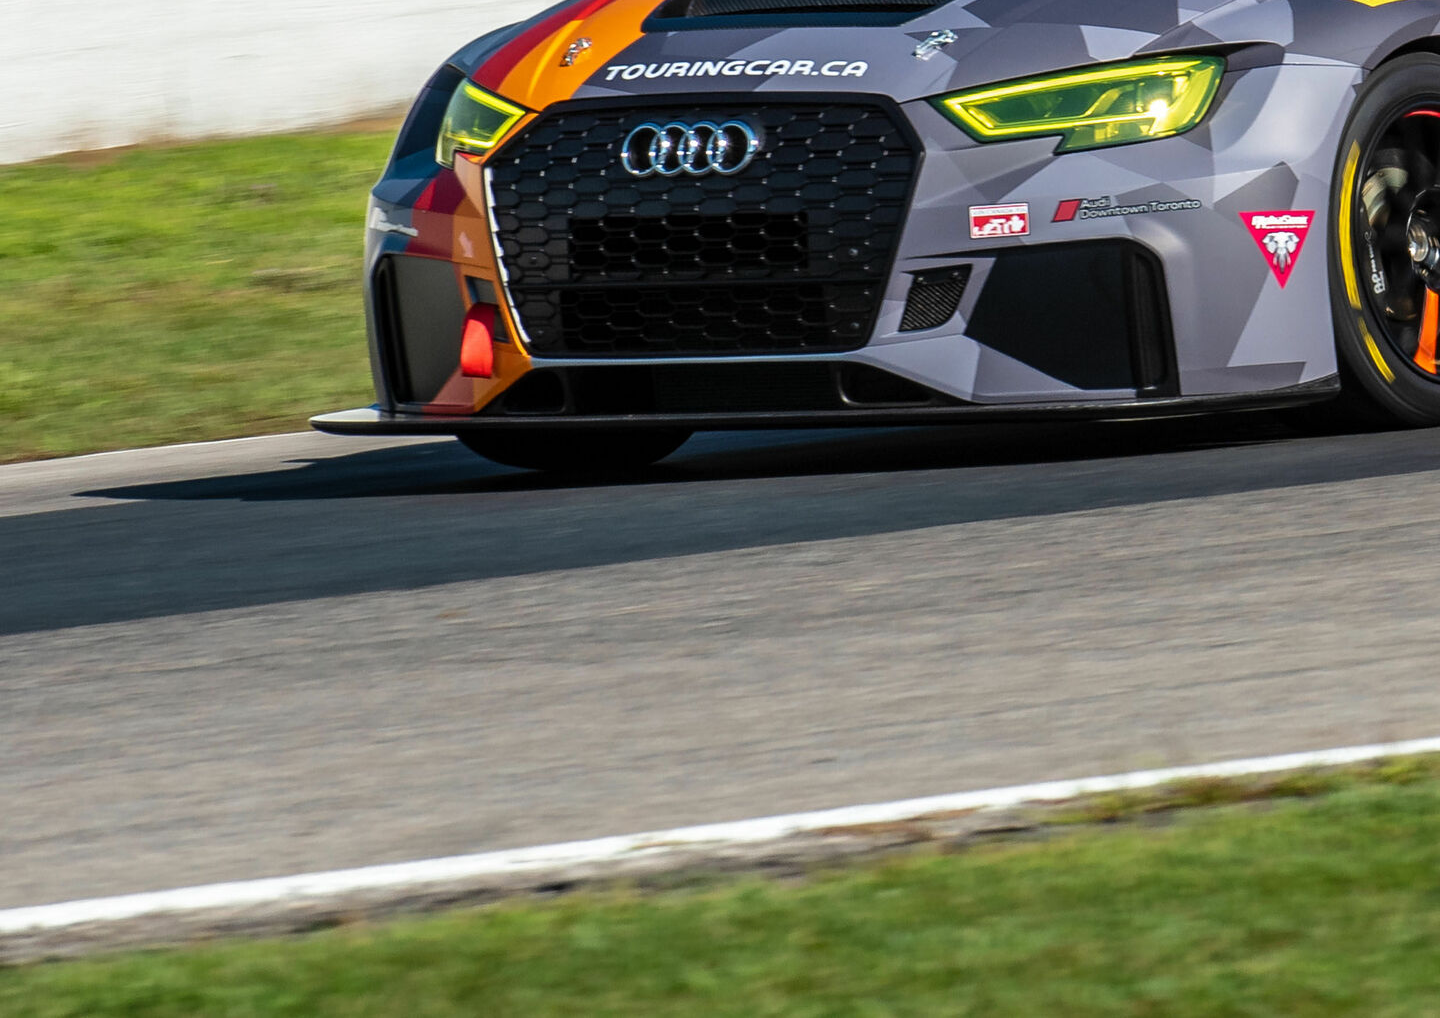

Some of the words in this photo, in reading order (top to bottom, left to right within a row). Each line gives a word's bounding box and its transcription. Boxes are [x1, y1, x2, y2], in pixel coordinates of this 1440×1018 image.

[605, 60, 869, 81] TOURINGCAR.CA
[1080, 197, 1111, 208] Audi
[1080, 204, 1148, 219] Downtown
[1150, 199, 1201, 211] Toronto
